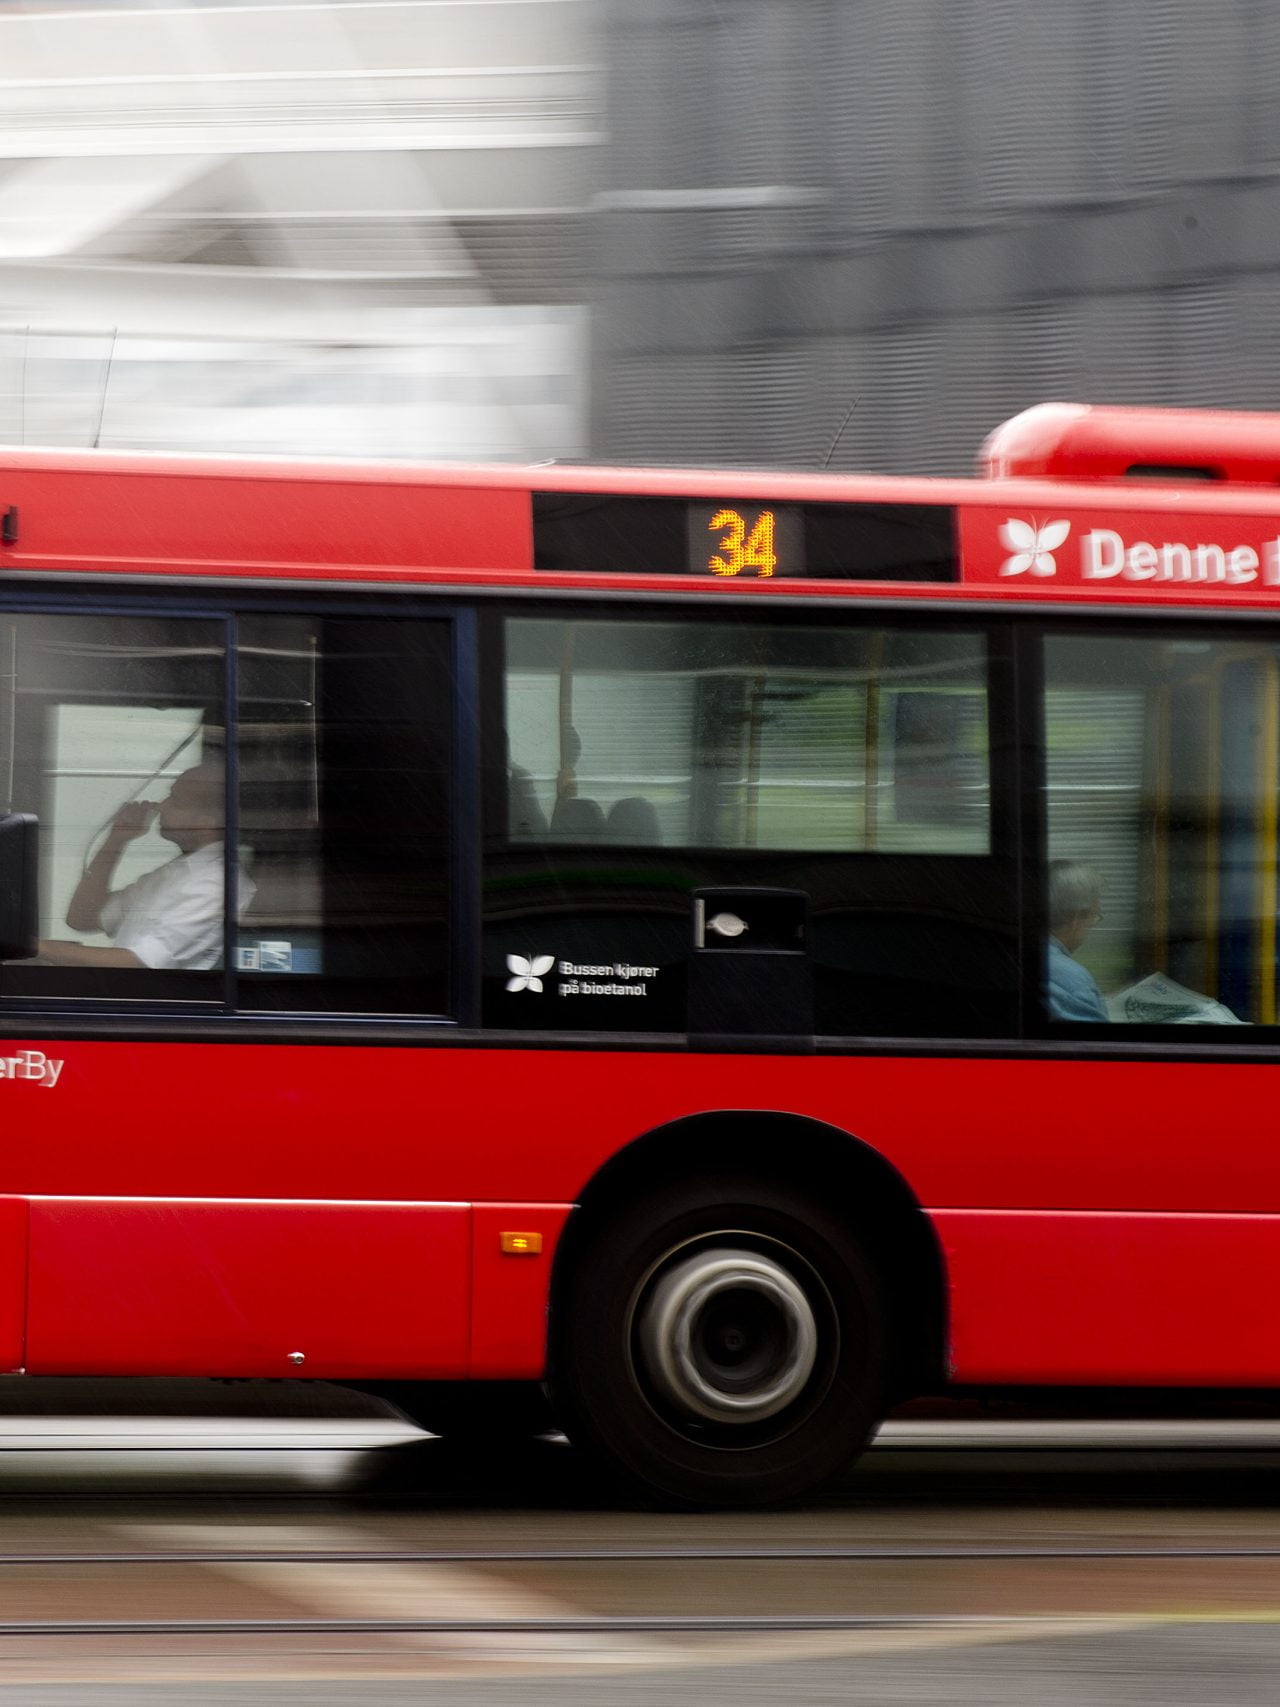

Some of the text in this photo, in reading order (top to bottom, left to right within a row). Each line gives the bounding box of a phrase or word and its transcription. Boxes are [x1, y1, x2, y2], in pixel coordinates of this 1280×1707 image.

[708, 509, 777, 577] 34
[1081, 528, 1259, 584] Denne
[560, 961, 660, 979] Bussen kjører
[561, 979, 648, 997] på bioetanol
